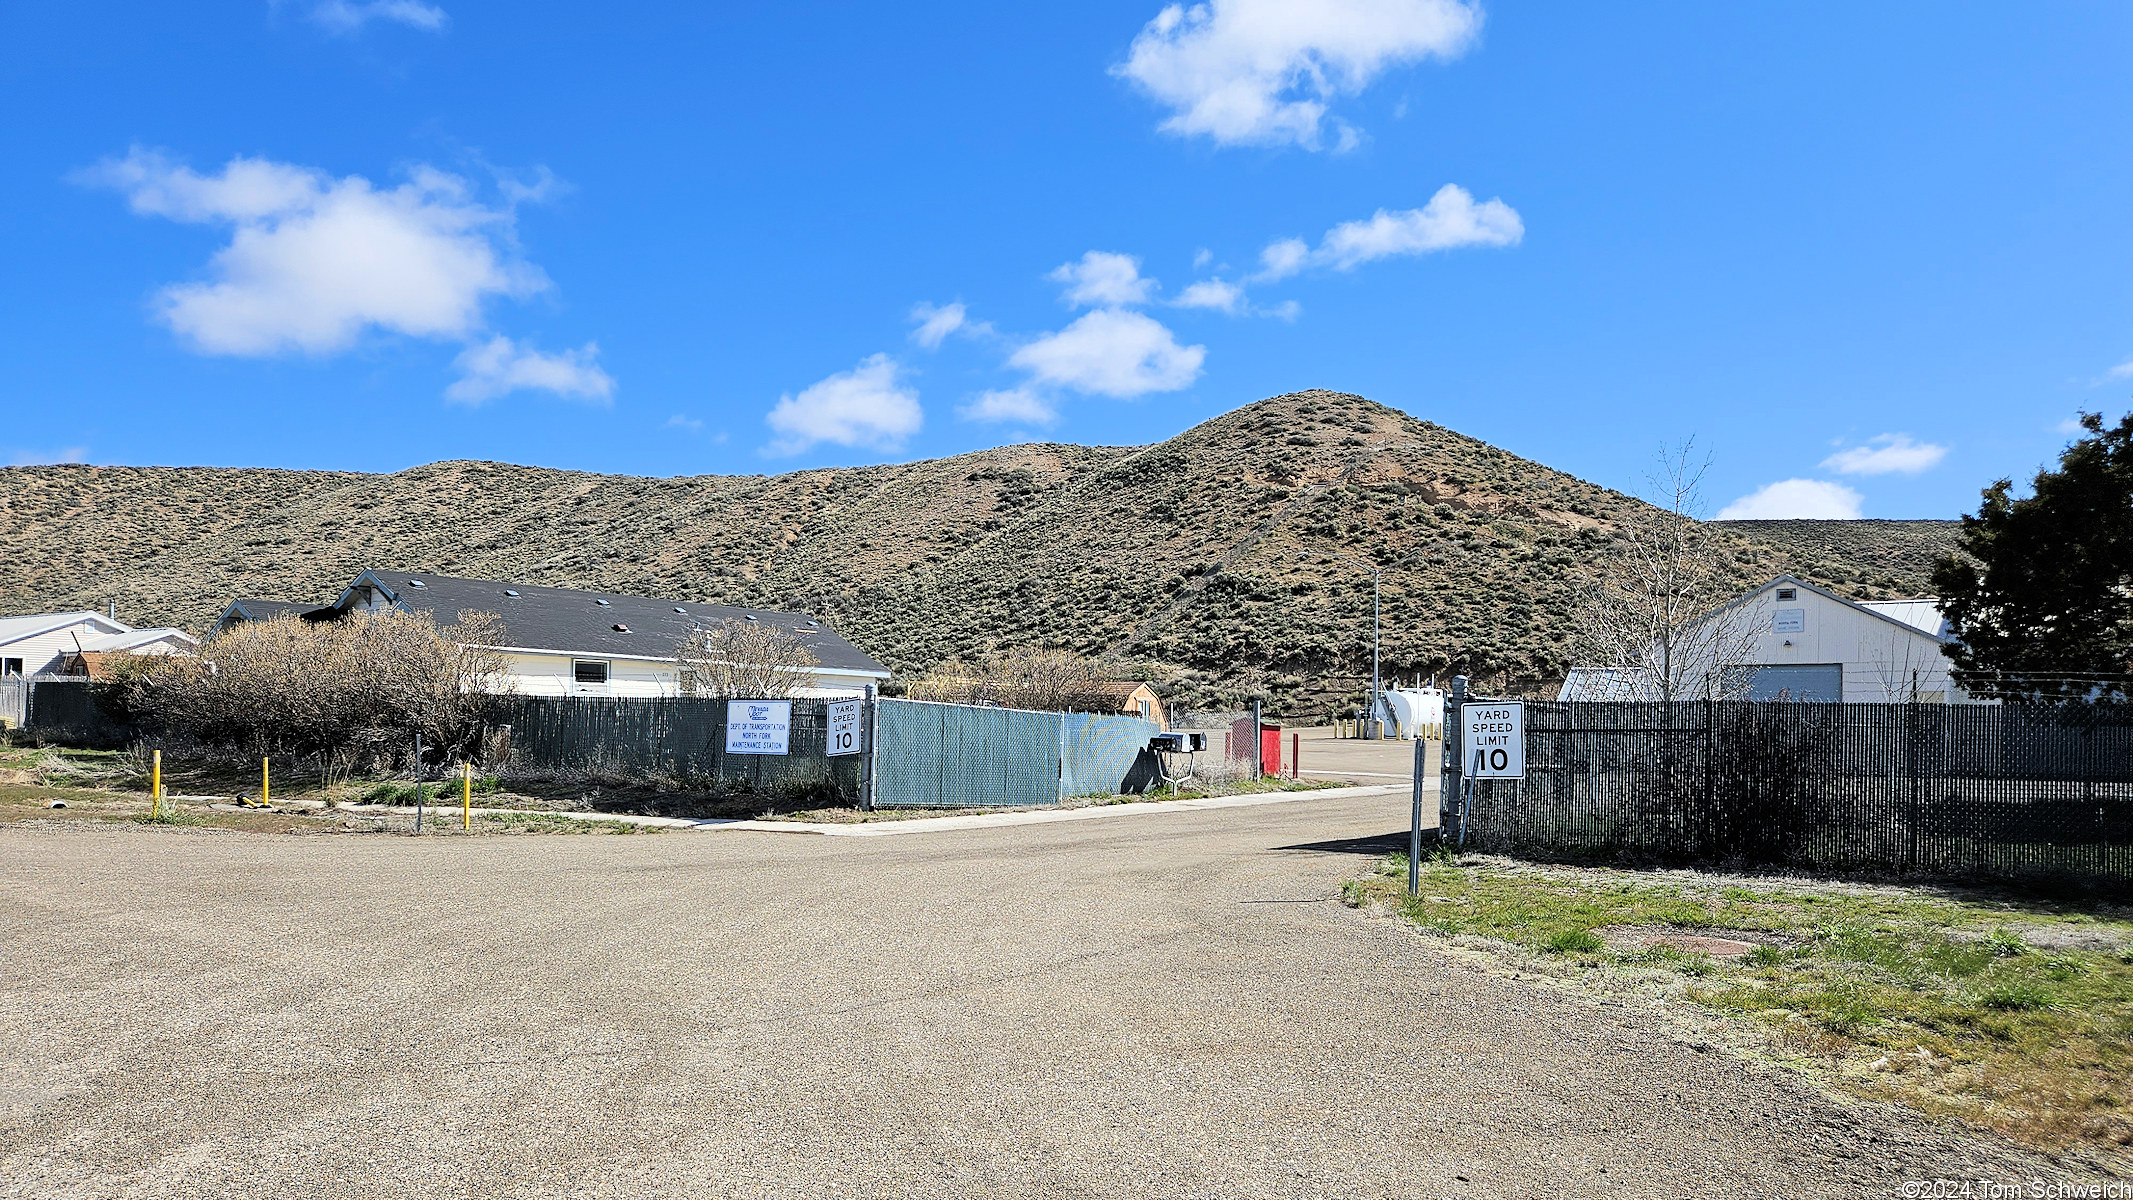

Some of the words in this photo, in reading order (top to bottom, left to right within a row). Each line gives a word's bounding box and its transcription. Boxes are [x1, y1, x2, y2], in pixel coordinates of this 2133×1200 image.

[835, 704, 855, 714] YARD
[833, 713, 856, 723] SPEED
[1475, 710, 1510, 720] YARD
[750, 723, 786, 731] TRANSPORTATION
[835, 722, 853, 732] LIMIT
[1472, 723, 1513, 733] SPEED
[742, 732, 757, 740] NORTH
[759, 732, 771, 740] FORK
[836, 732, 852, 750] 10
[1476, 735, 1508, 746] LIMIT
[732, 741, 761, 749] MAINTENANCE
[763, 741, 783, 750] STATION
[1479, 748, 1508, 771] 10
